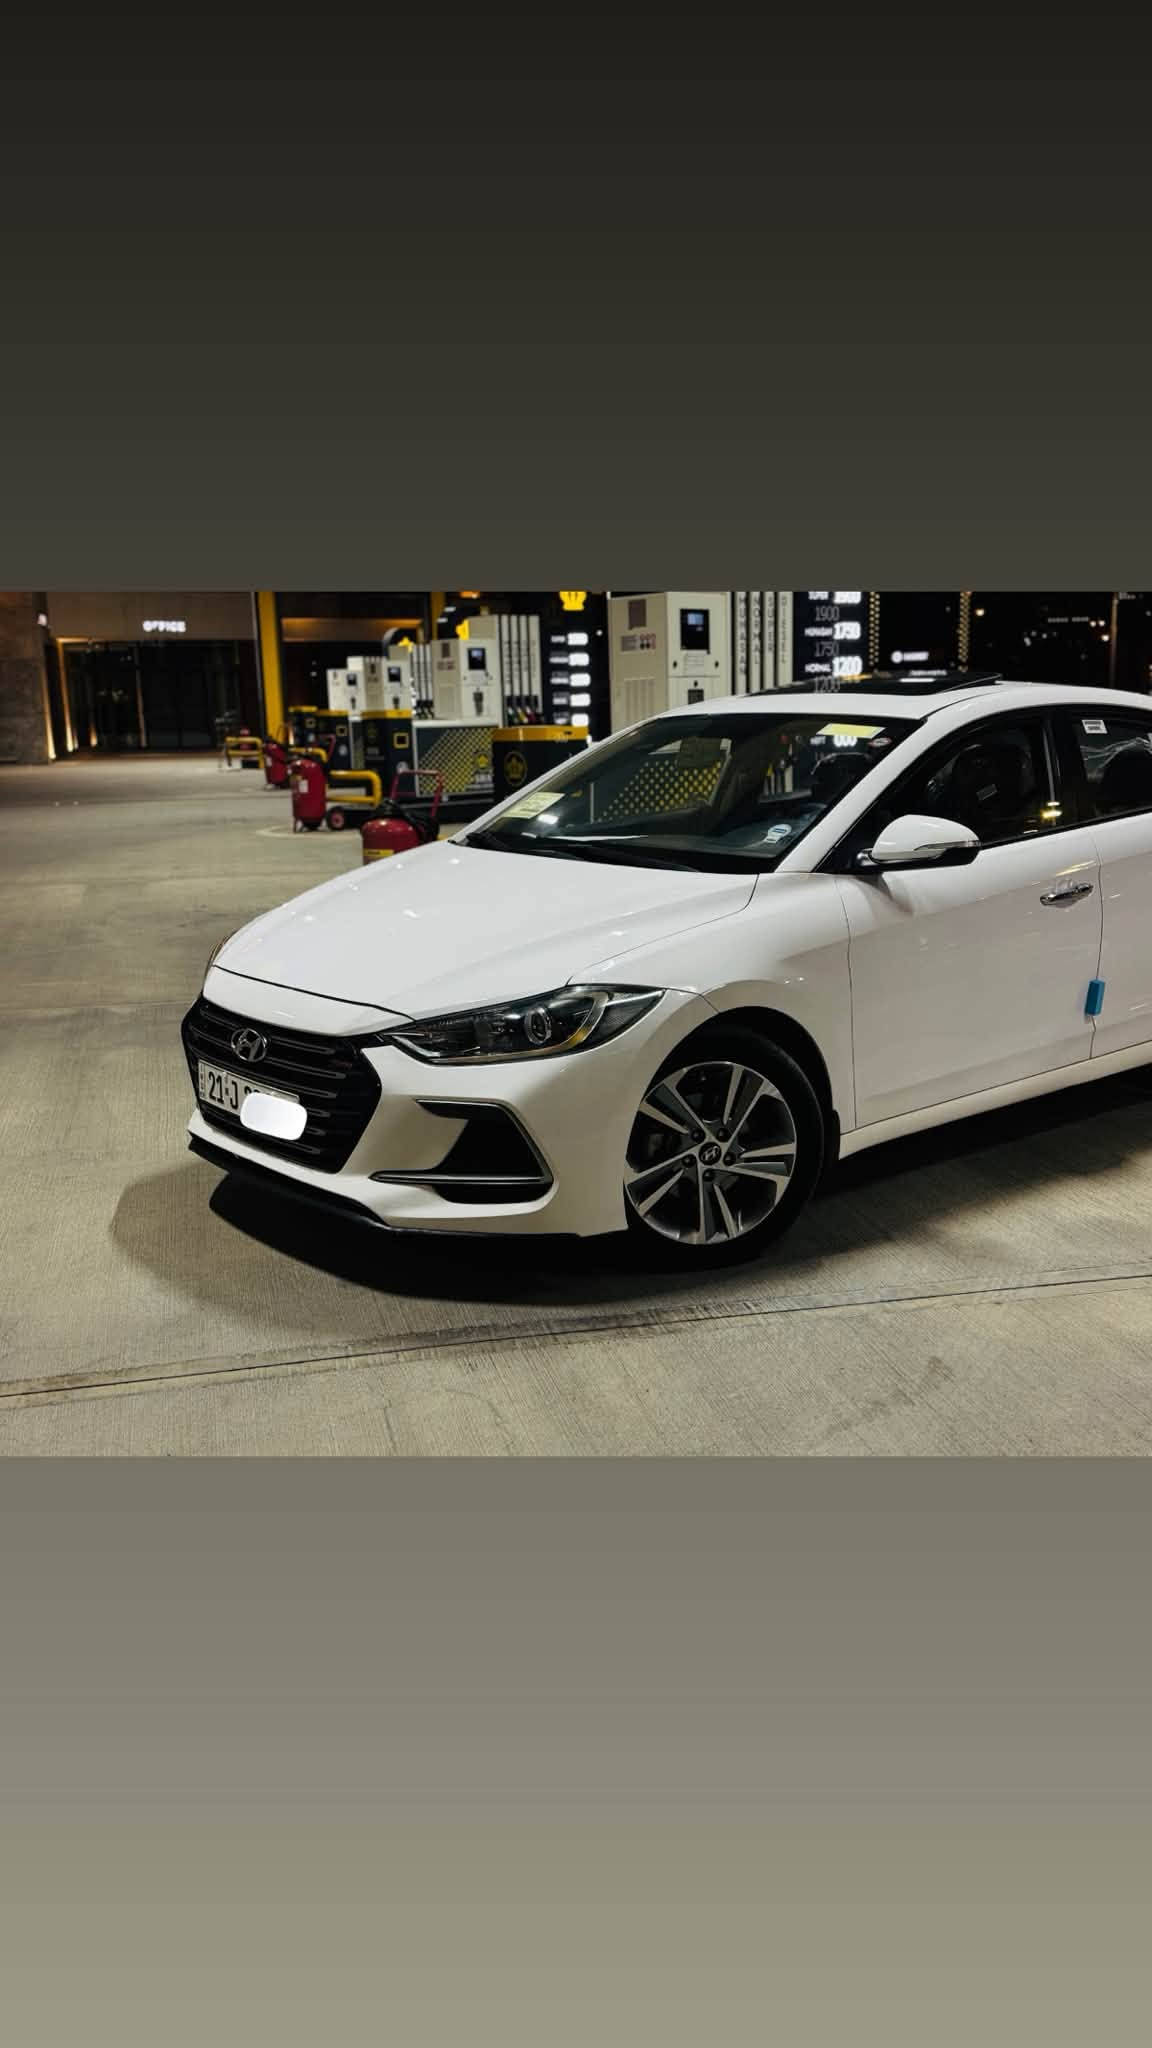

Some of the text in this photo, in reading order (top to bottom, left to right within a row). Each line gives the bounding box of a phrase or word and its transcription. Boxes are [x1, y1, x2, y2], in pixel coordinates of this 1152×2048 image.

[815, 606, 840, 621] 1900
[143, 620, 187, 632] OFFICE
[833, 621, 862, 640] 1750
[832, 655, 863, 678] 1200
